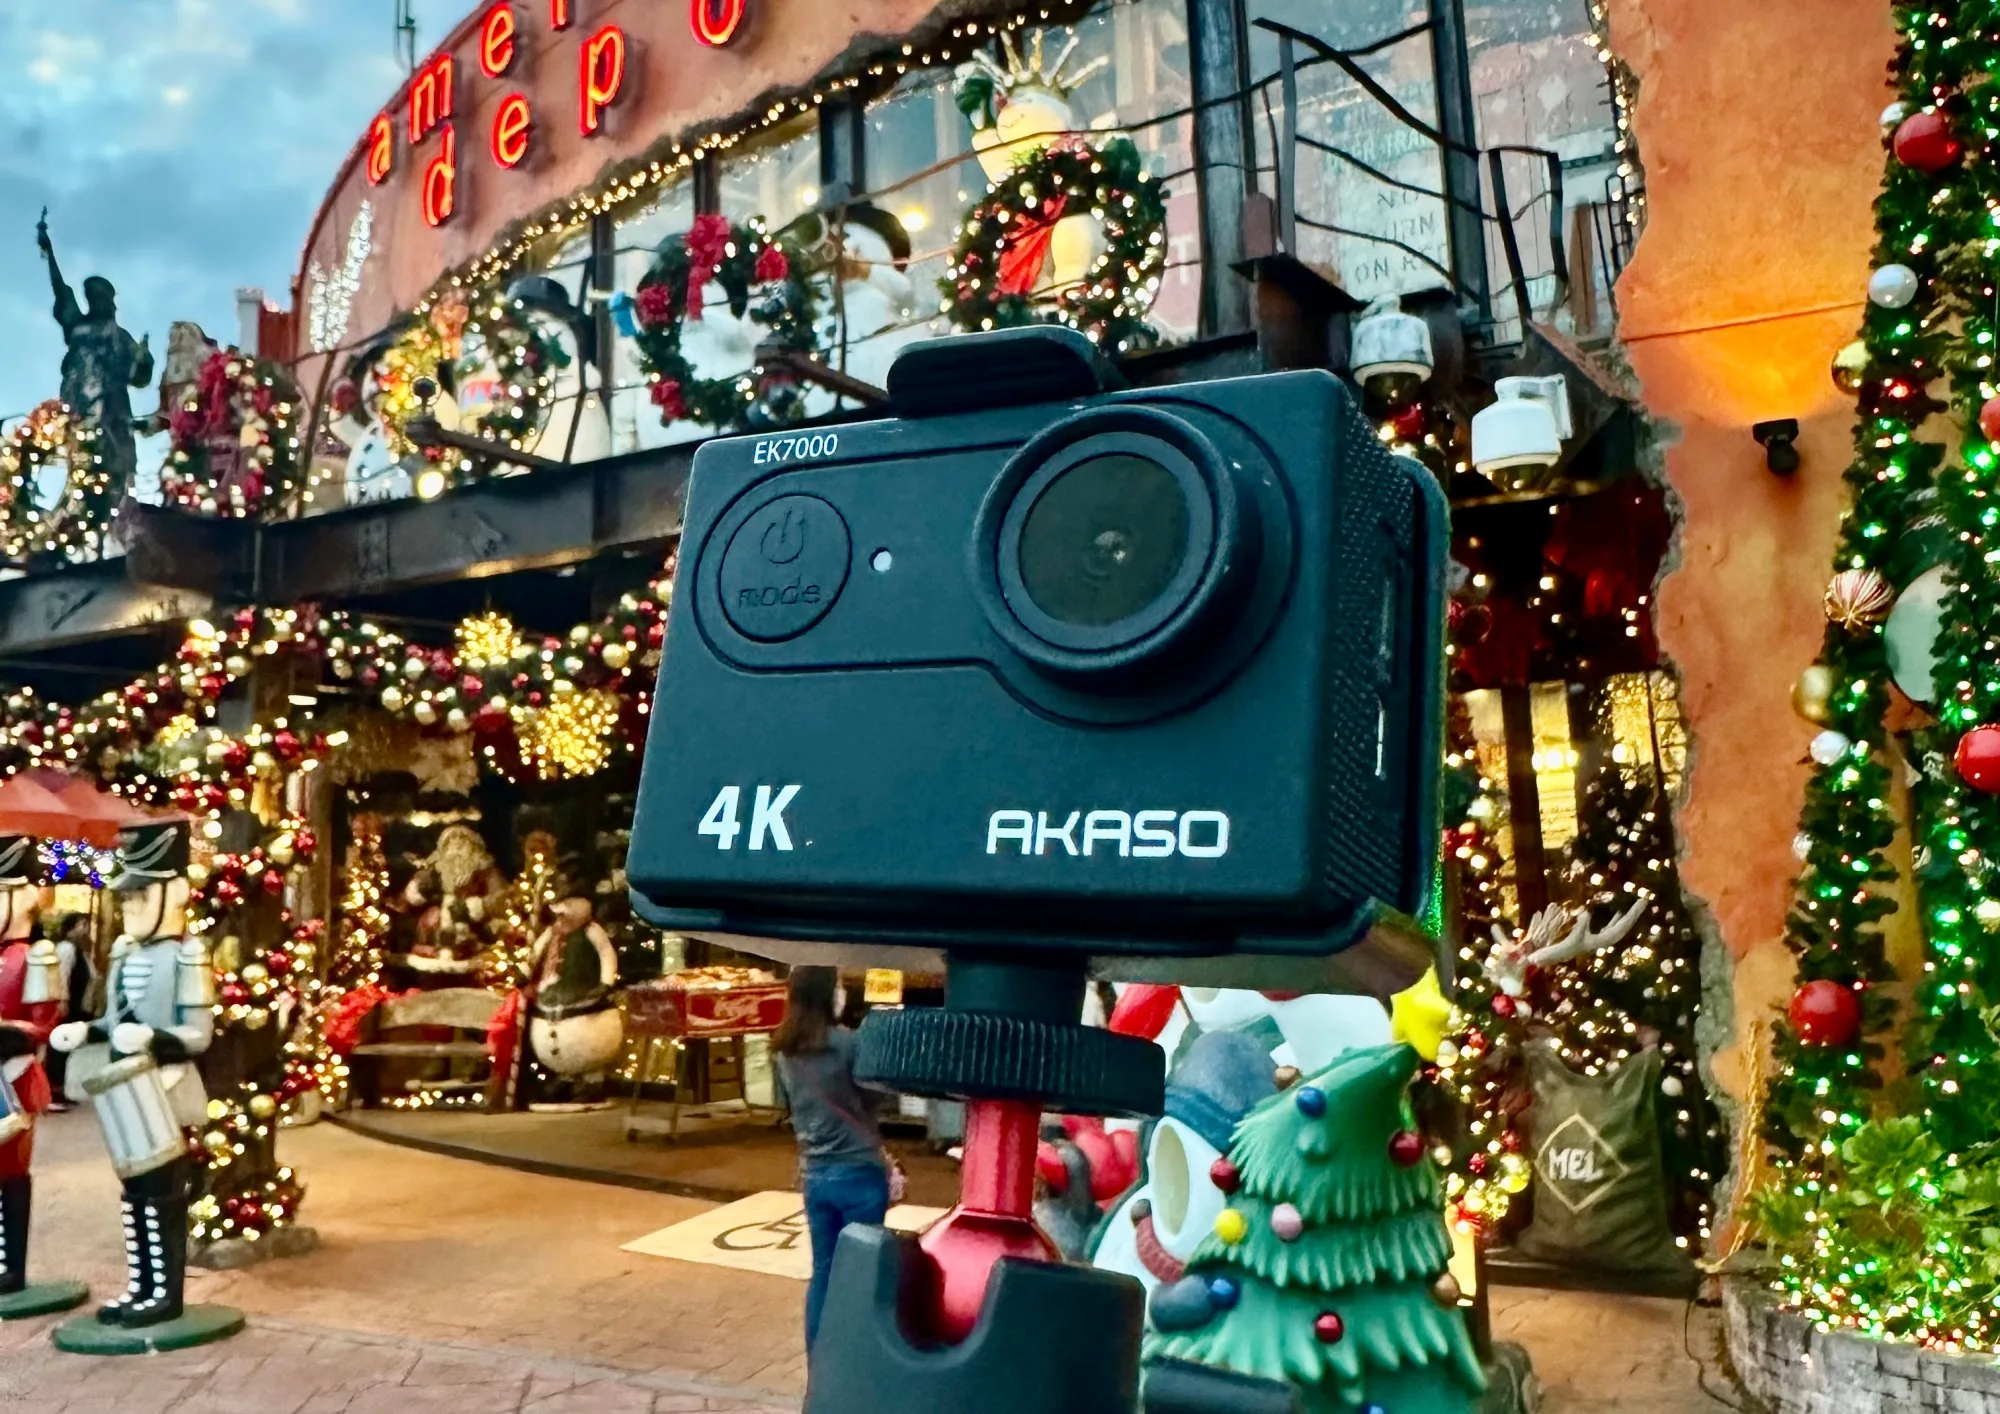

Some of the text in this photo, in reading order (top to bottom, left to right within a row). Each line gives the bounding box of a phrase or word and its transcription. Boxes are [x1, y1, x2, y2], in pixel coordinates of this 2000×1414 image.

[753, 433, 839, 465] EK7000
[738, 575, 821, 608] mode
[698, 785, 802, 851] 4K
[986, 809, 1230, 858] AKASO
